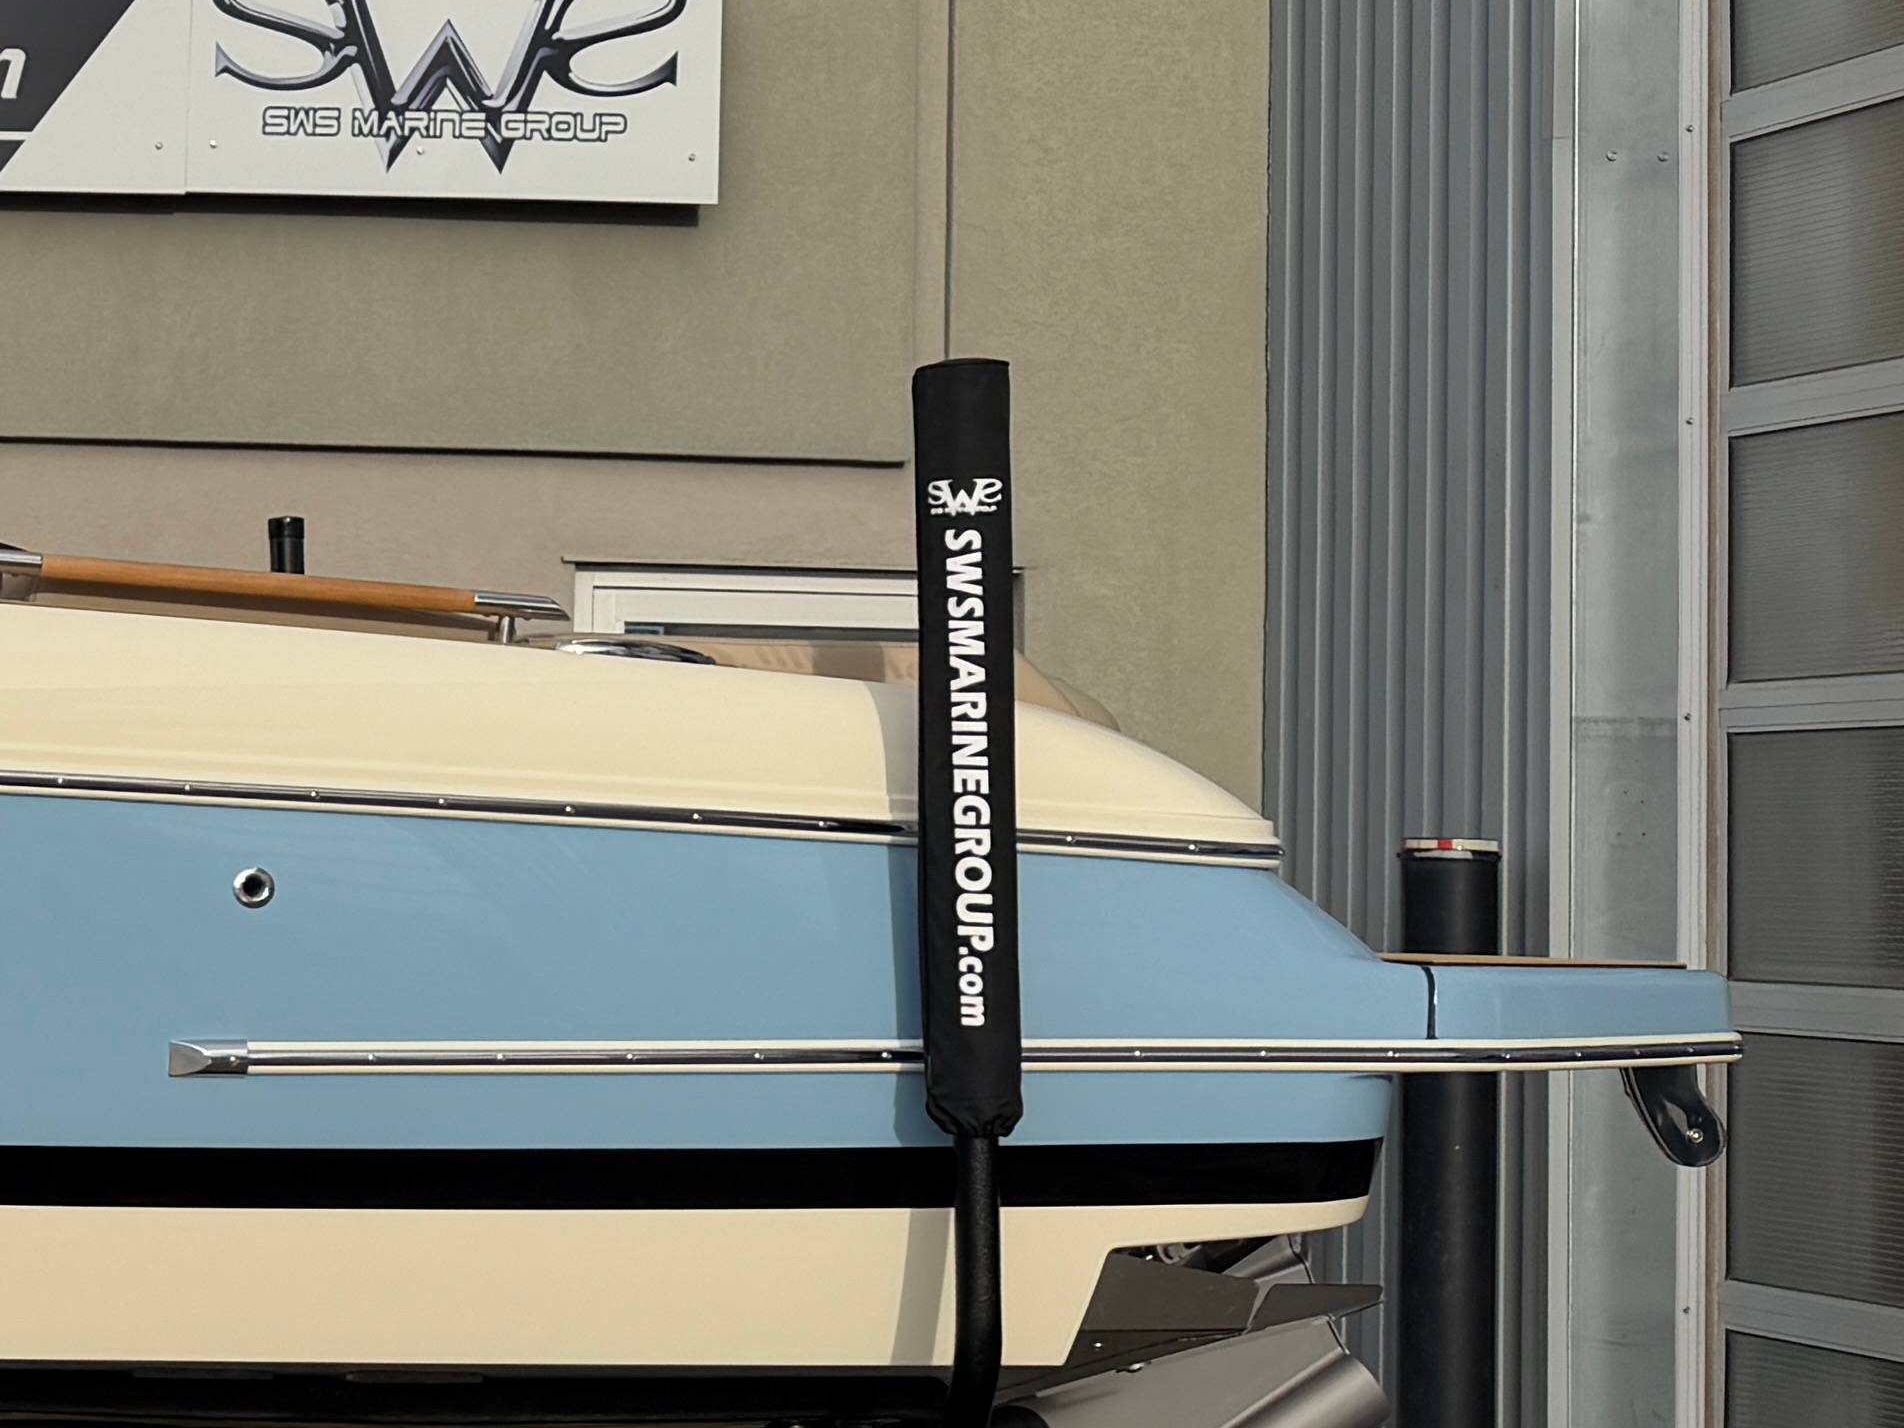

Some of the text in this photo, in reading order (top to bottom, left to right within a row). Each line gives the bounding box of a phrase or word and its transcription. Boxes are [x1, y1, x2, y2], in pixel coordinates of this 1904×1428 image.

[262, 106, 628, 143] SWS MARINE GROUP
[945, 528, 995, 1028] SWSMARINEGROUP.com
